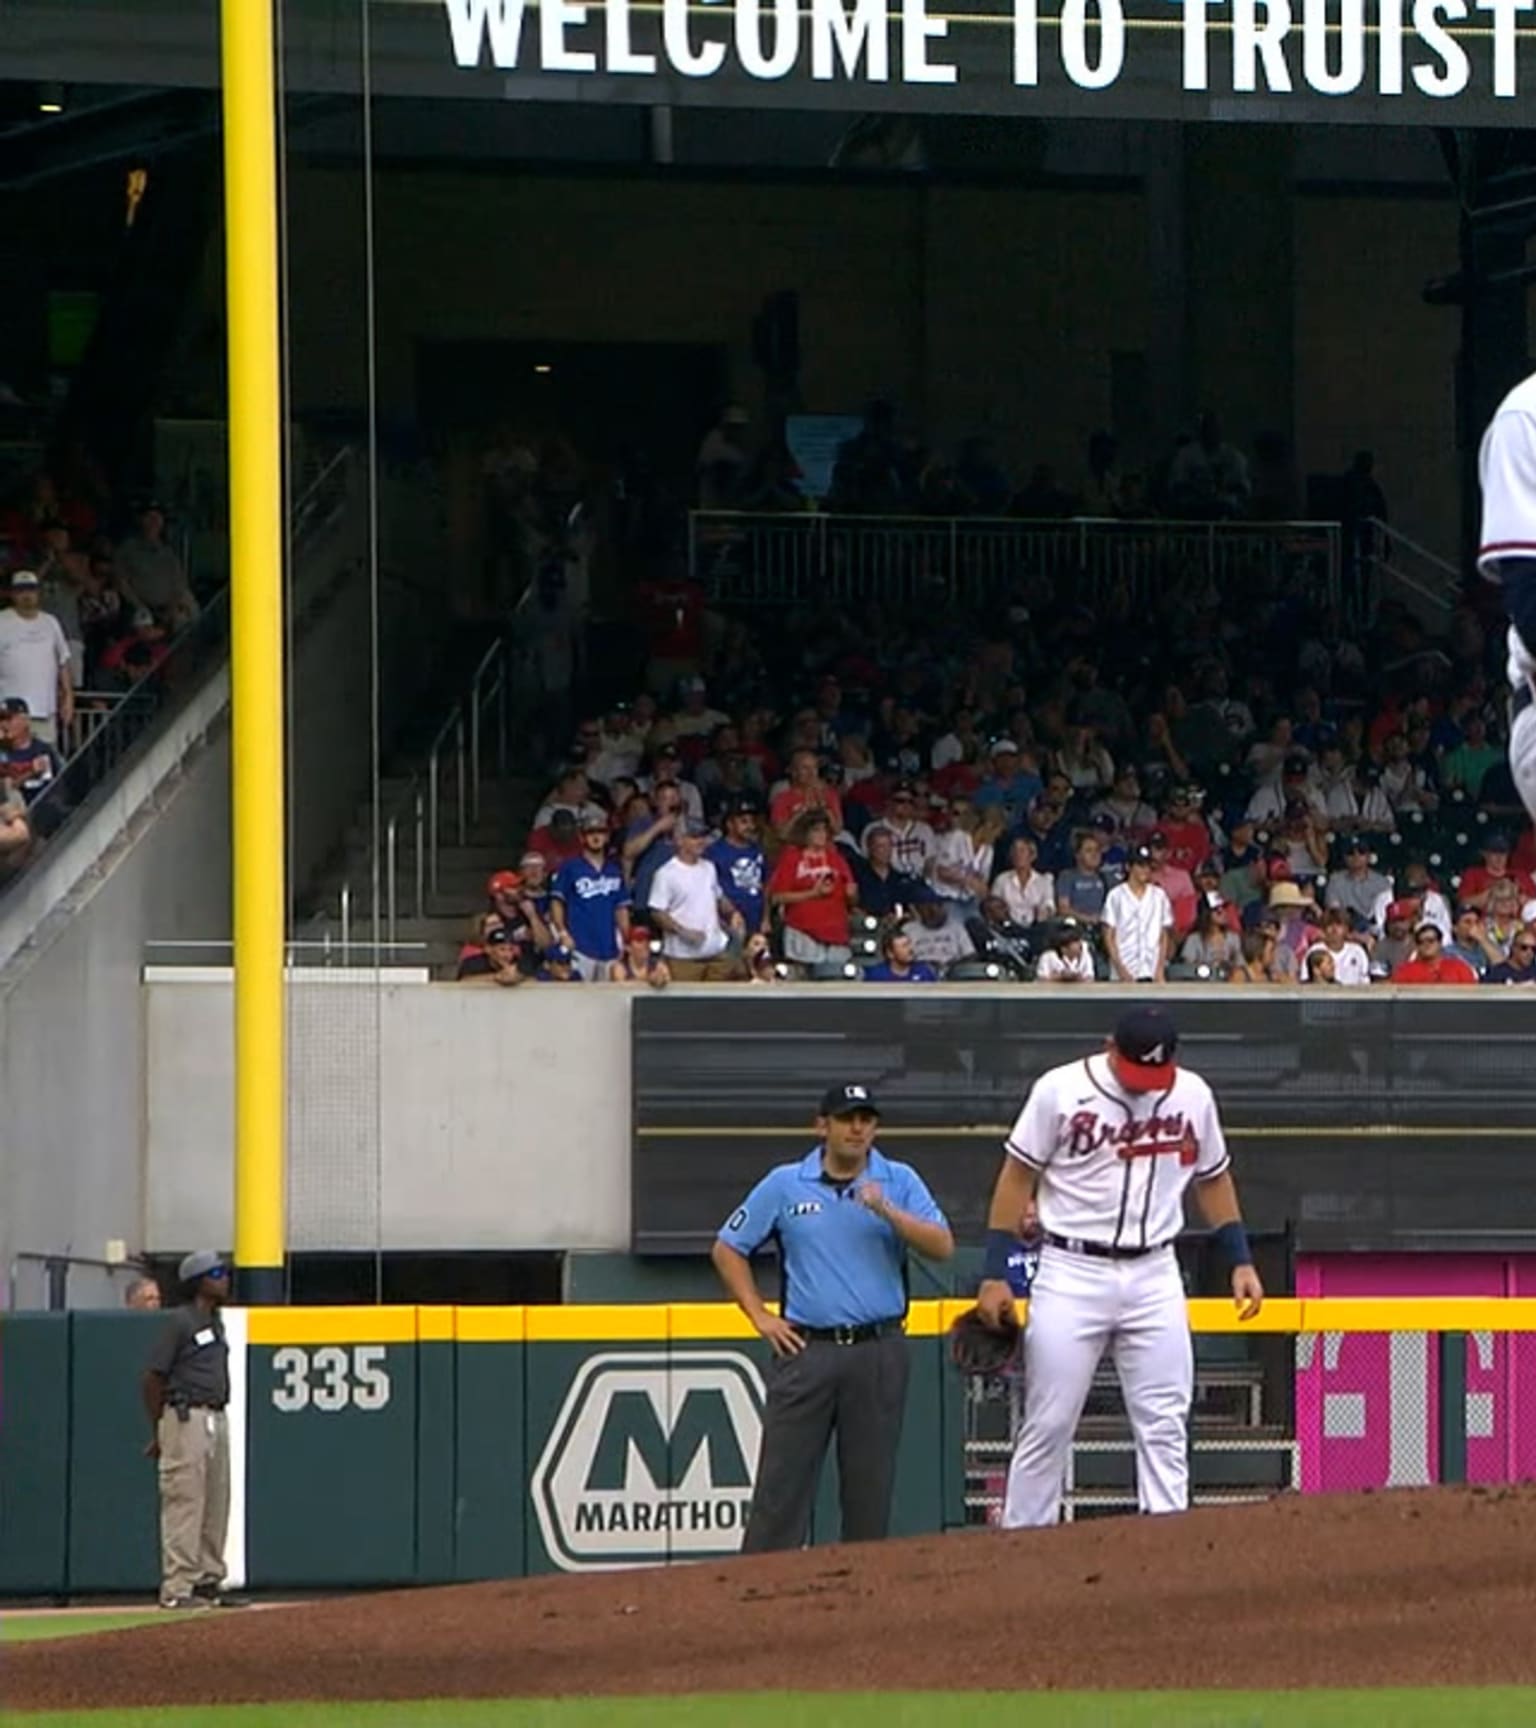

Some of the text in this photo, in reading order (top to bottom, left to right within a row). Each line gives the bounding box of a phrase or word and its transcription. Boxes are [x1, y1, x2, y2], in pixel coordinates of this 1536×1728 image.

[443, 0, 957, 83] WELCOME
[1013, 0, 1125, 89] TO
[1168, 0, 1533, 97] TRUIST
[272, 1345, 390, 1412] 335
